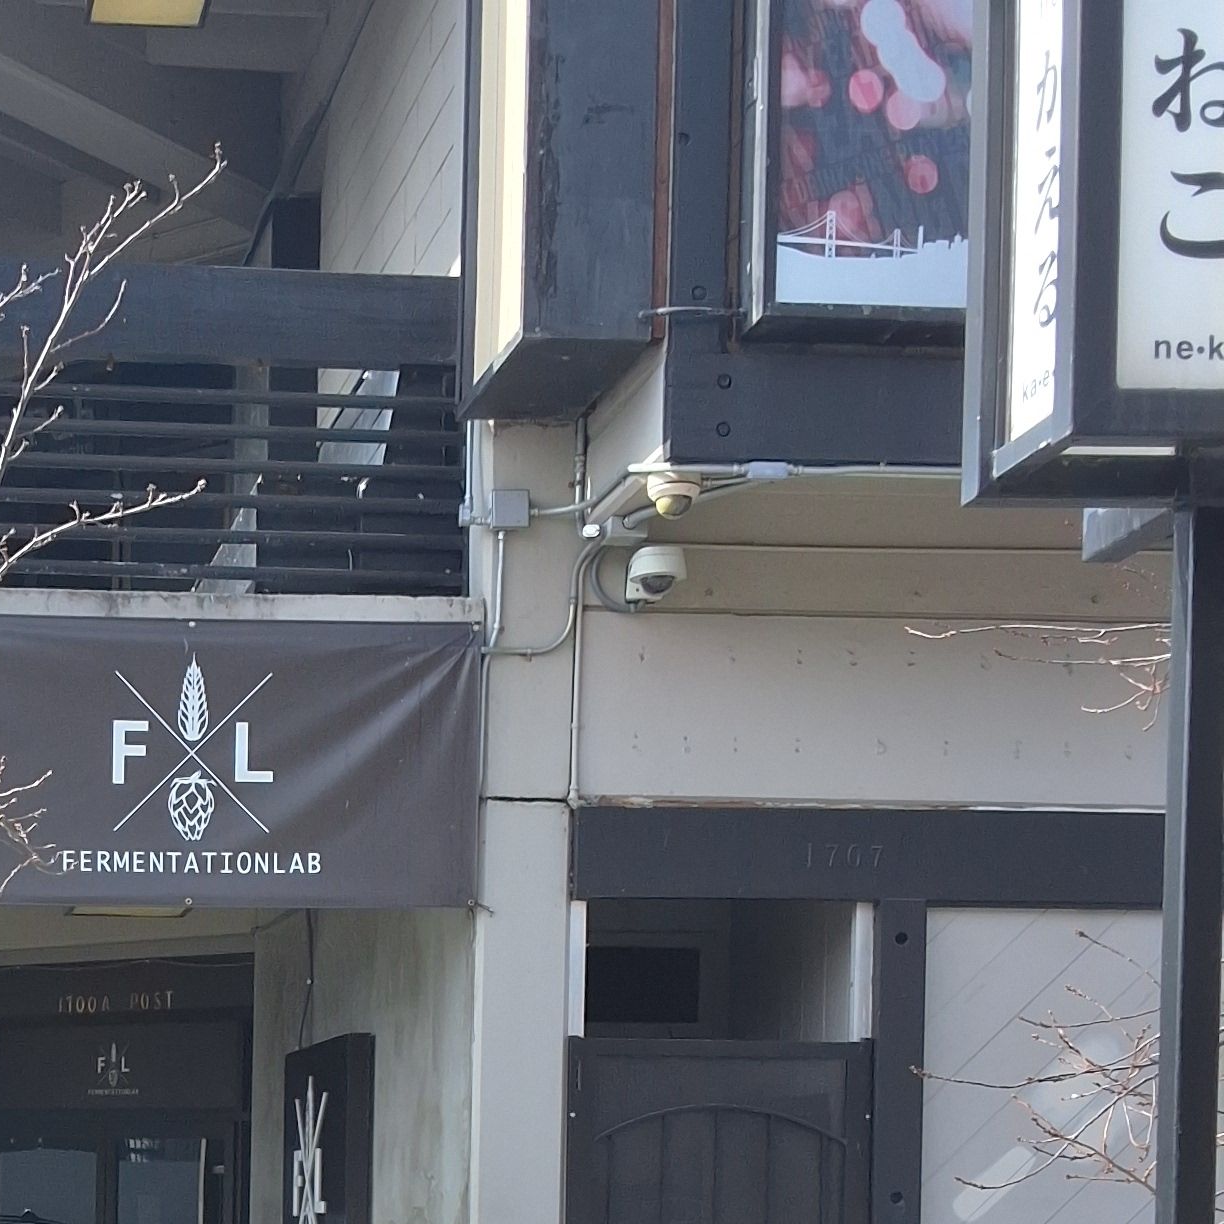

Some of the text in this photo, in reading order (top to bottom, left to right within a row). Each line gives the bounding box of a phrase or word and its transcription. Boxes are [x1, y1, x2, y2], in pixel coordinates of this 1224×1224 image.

[112, 719, 274, 785] F L
[62, 850, 322, 875] FERMENTATIONLAB
[129, 990, 173, 1010] POST
